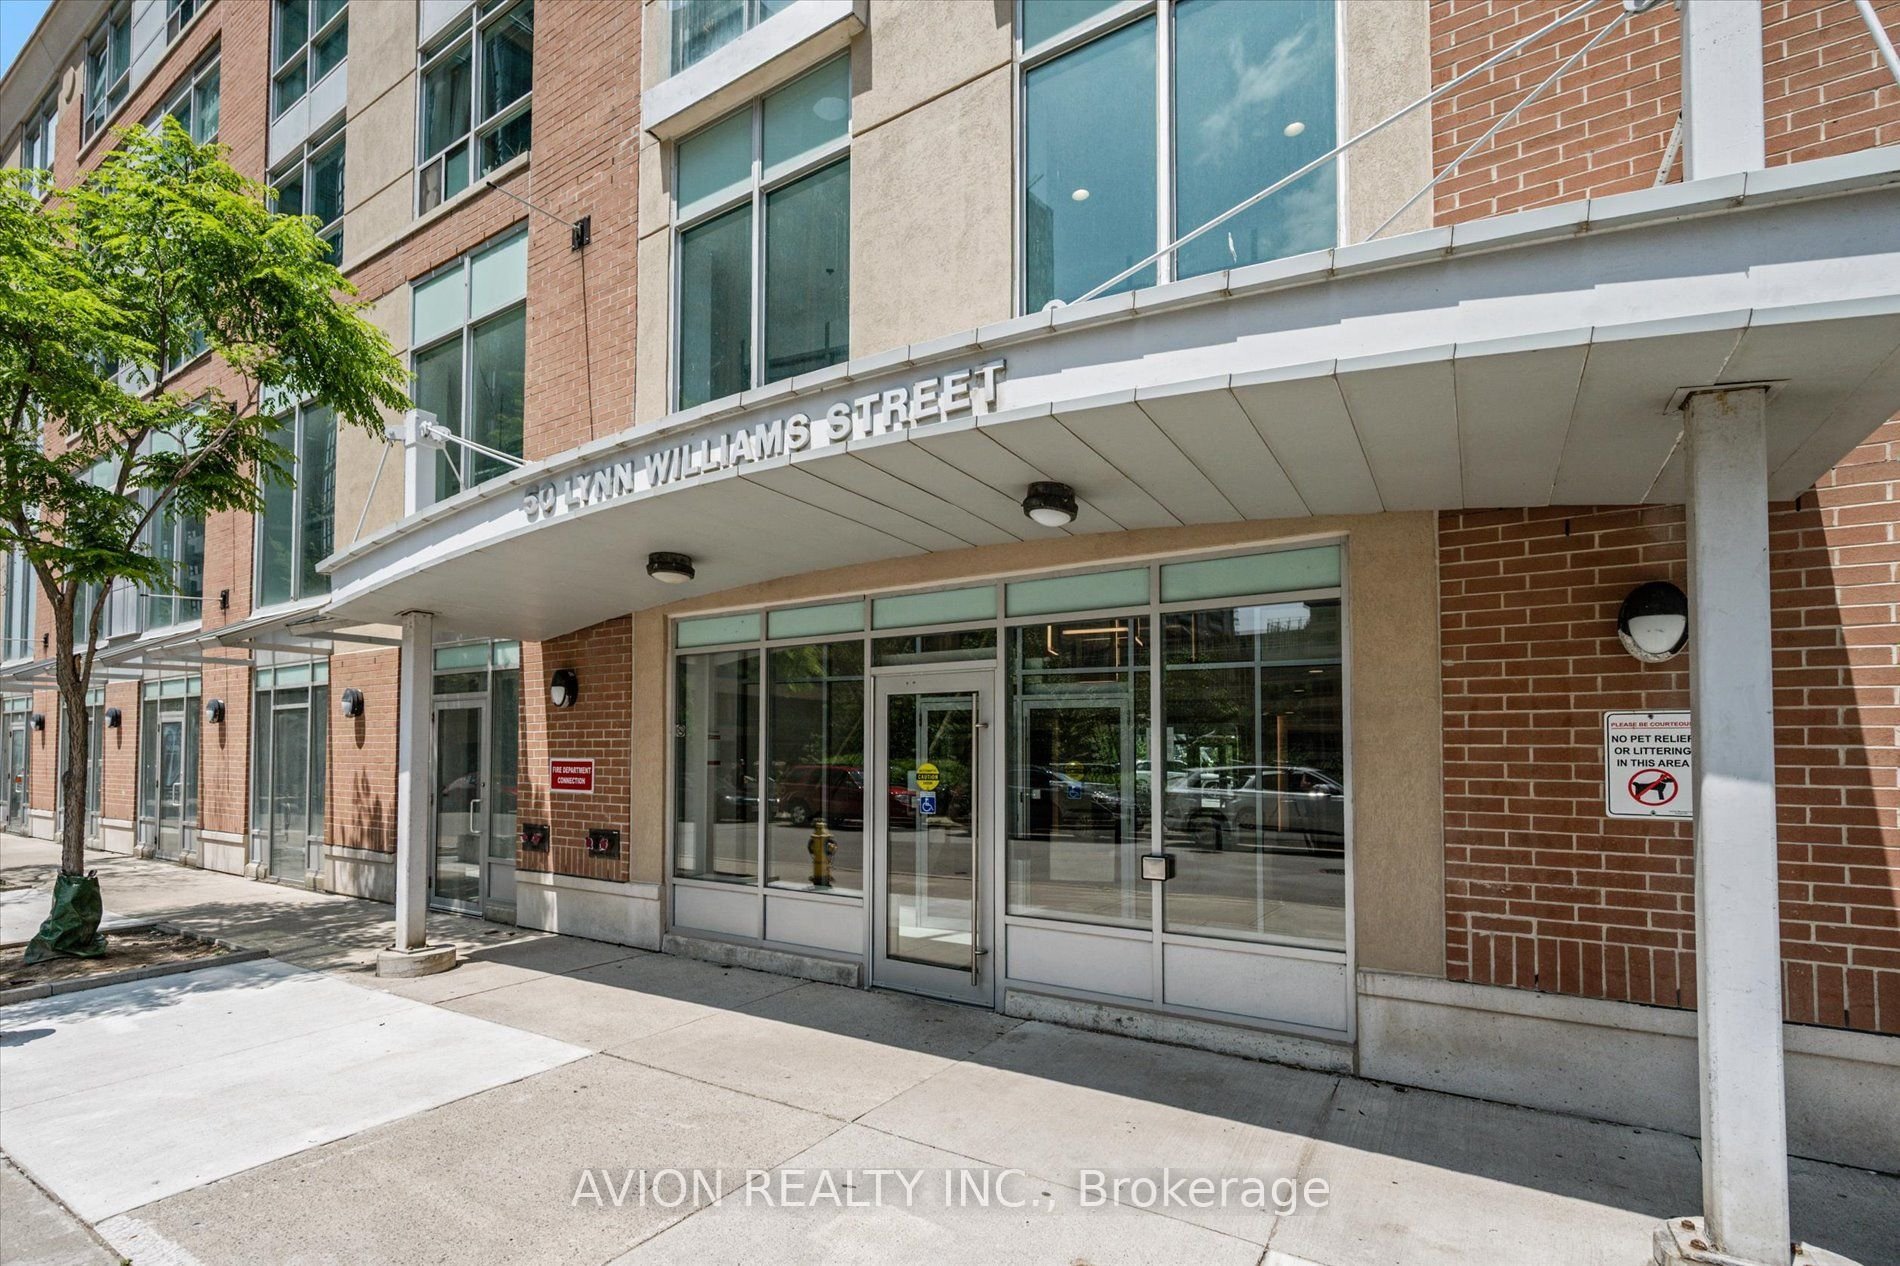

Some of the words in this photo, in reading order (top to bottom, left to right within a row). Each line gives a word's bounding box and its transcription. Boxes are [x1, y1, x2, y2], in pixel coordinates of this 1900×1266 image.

[523, 482, 557, 520] 50
[565, 461, 634, 509] LYNN
[645, 414, 811, 486] WILLIAMS
[826, 359, 1006, 440] STREET
[1611, 735, 1627, 743] NO
[1630, 735, 1651, 743] PET
[1614, 747, 1630, 755] OR
[1633, 747, 1691, 755] LITTERING
[1617, 759, 1627, 767] IN
[1631, 759, 1655, 767] THIS
[1658, 759, 1690, 767] AREA
[563, 766, 591, 774] DEPARTMENT
